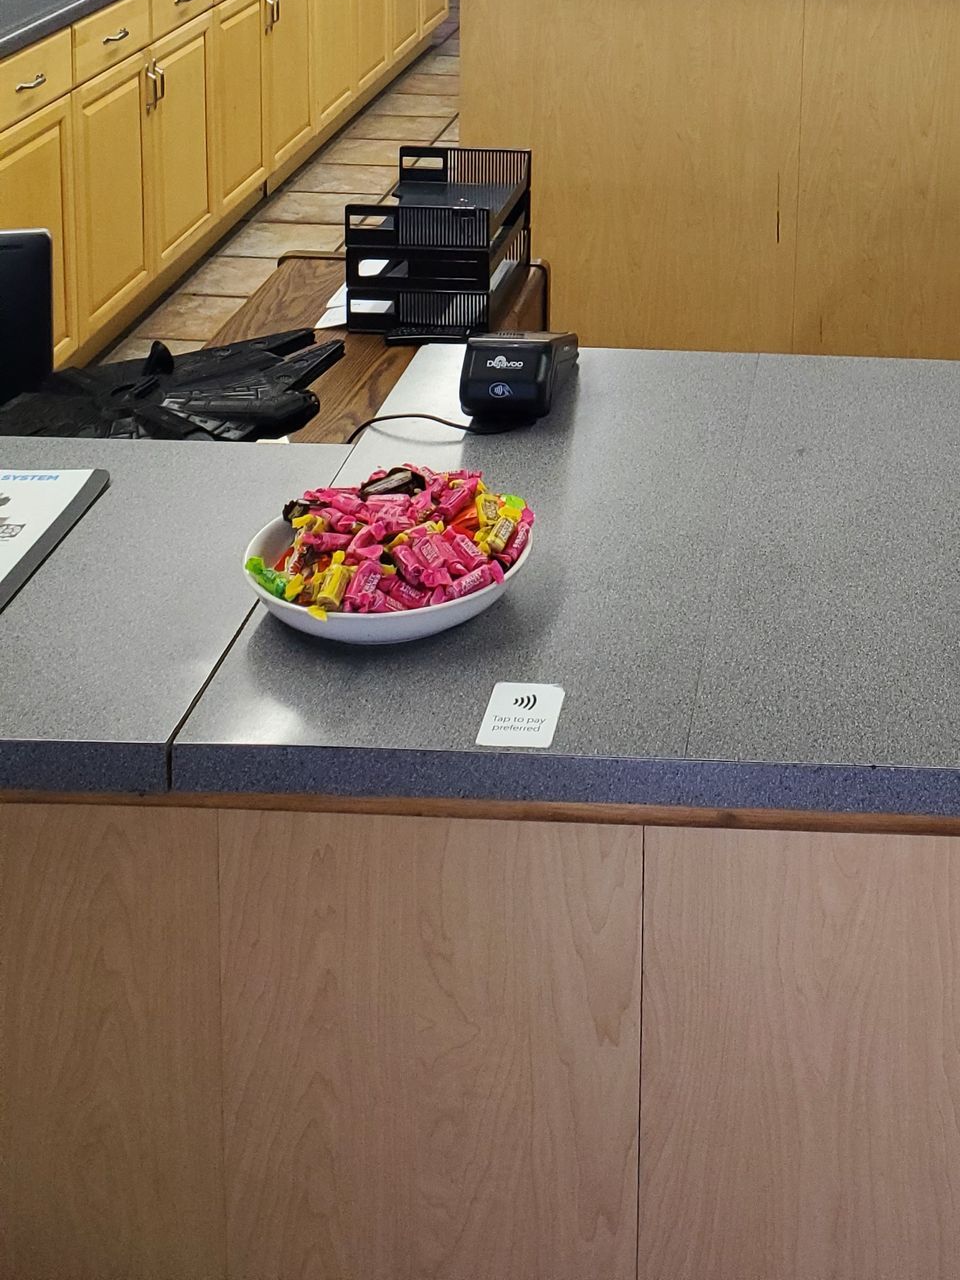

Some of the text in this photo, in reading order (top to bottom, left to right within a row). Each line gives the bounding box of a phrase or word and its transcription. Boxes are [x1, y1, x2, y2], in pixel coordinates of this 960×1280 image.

[493, 715, 510, 723] Tap
[526, 716, 546, 724] pay
[491, 724, 541, 732] preferred
